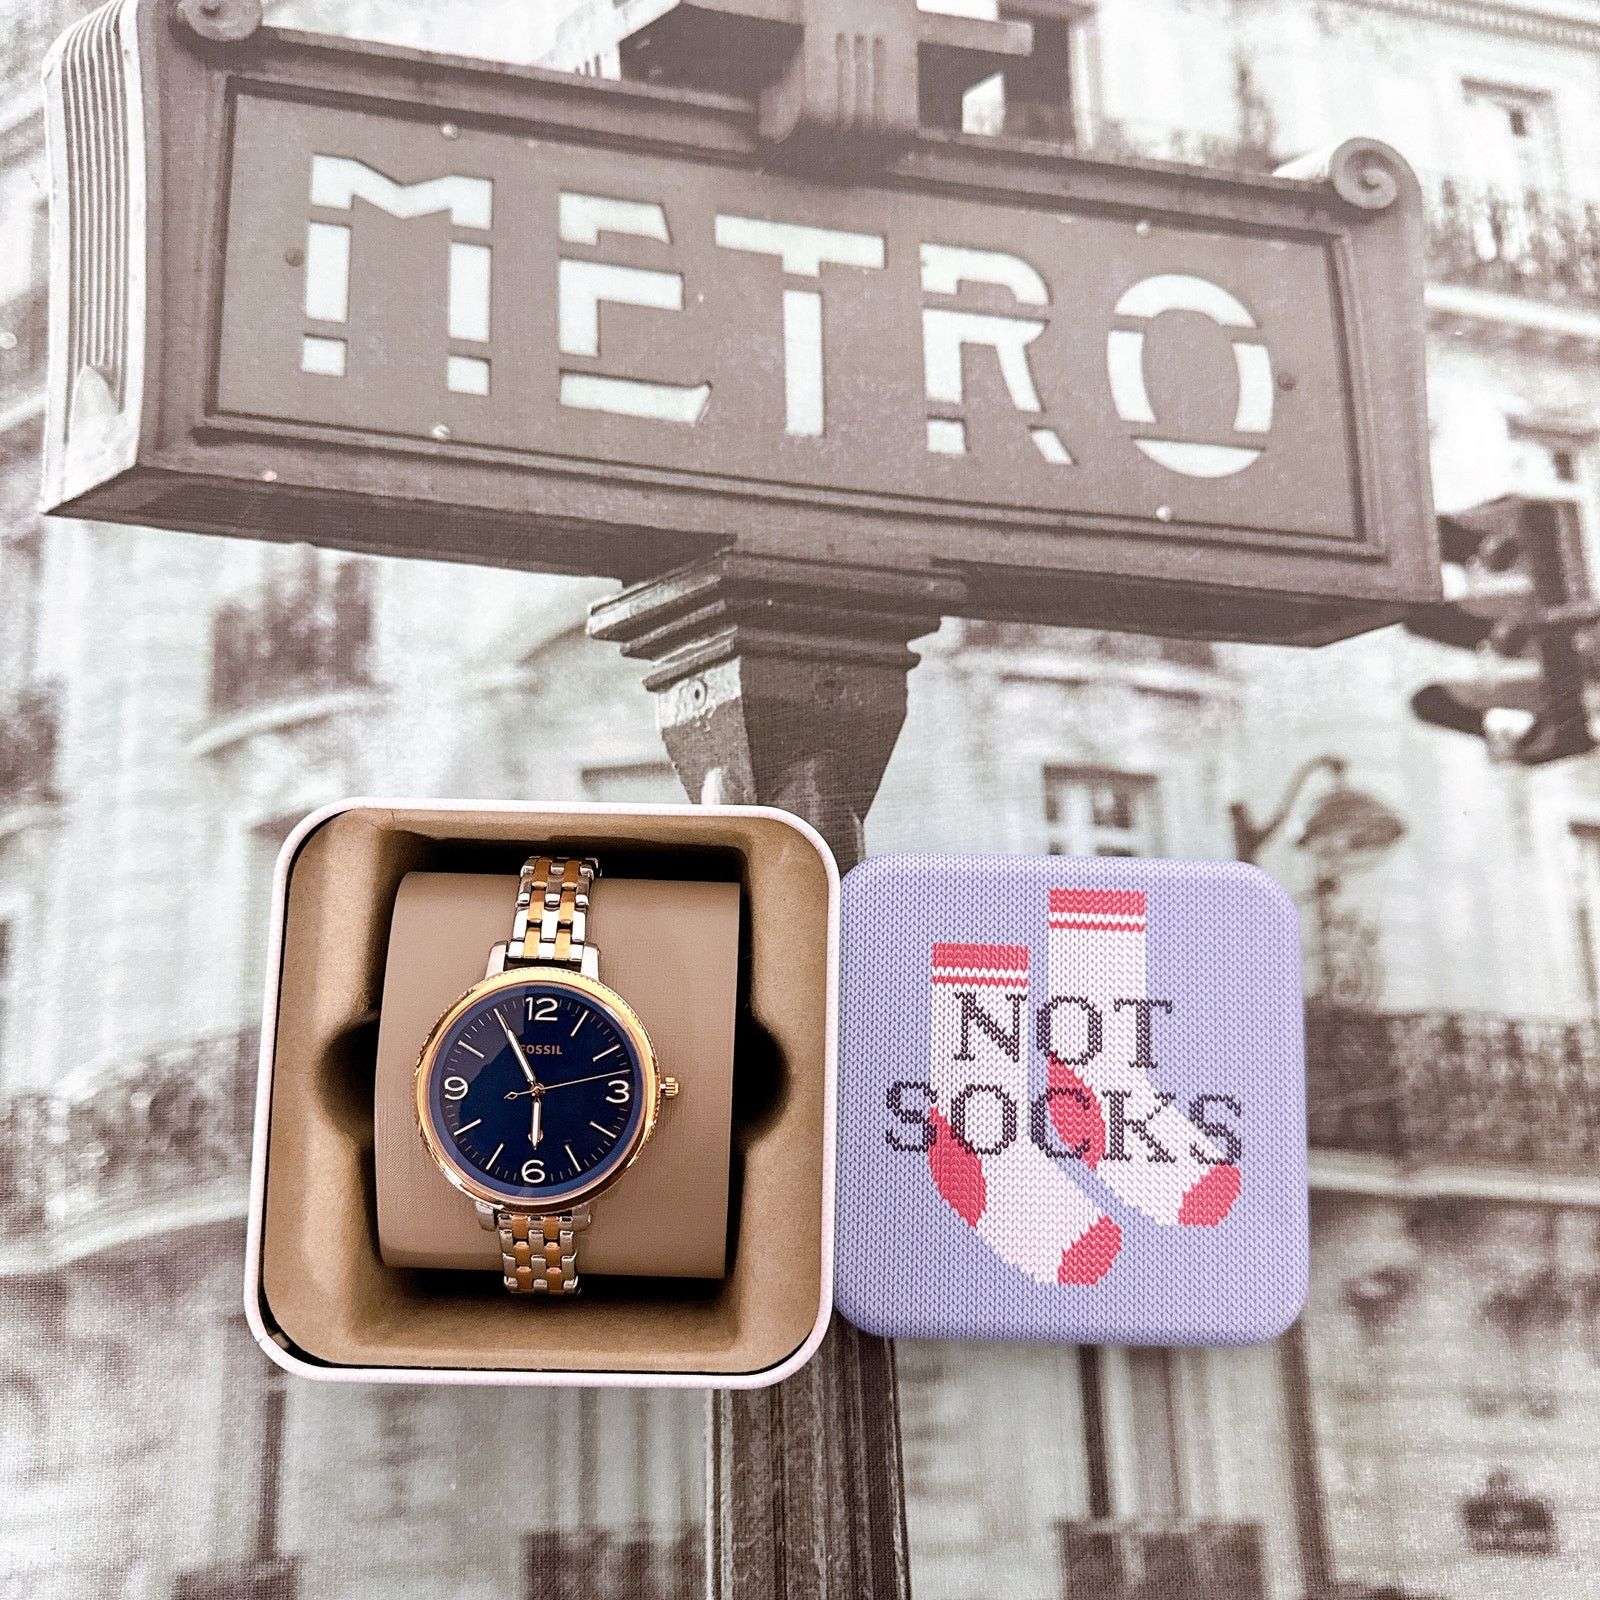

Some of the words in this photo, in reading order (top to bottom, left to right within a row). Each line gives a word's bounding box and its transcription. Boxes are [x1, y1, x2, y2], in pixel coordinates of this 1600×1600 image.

[300, 153, 1274, 478] METRO
[525, 996, 558, 1021] 12
[953, 991, 1172, 1068] NOT
[444, 1076, 468, 1100] 9
[605, 1079, 630, 1103] 3
[885, 1082, 1242, 1165] SOCKS
[521, 1159, 545, 1183] 6
